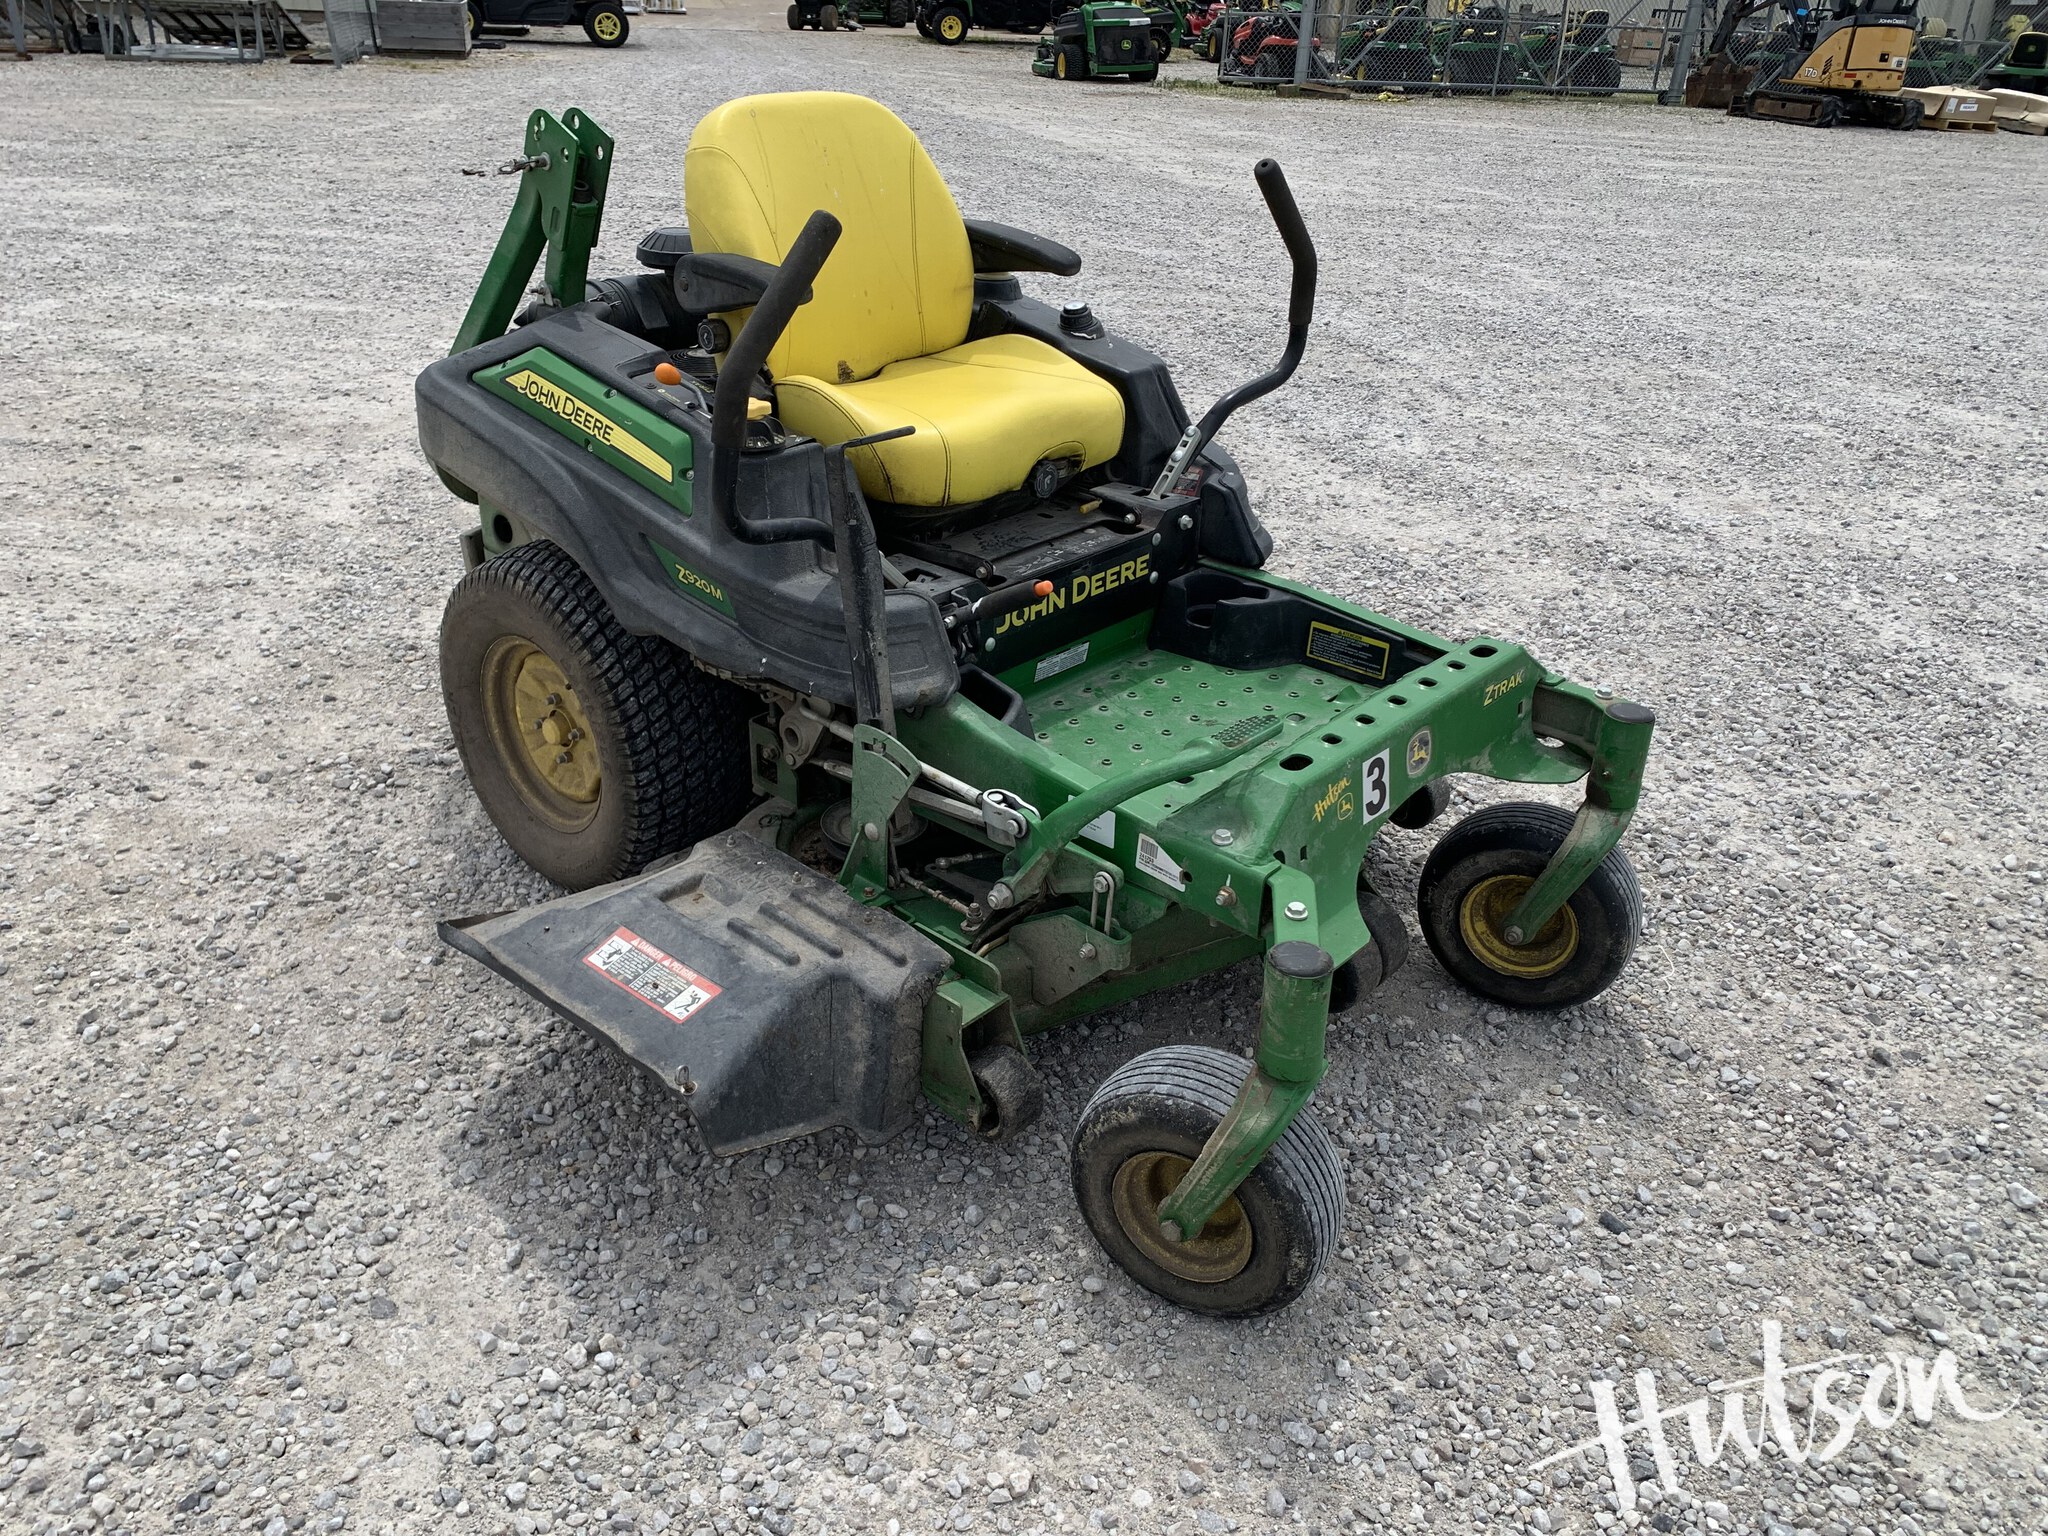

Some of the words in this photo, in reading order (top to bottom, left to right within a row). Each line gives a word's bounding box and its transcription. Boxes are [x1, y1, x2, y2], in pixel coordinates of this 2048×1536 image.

[1804, 67, 1819, 78] 17D
[519, 374, 560, 411] JOHN
[561, 396, 614, 443] DEERE
[675, 563, 723, 601] Z920M
[996, 588, 1065, 634] JOHN
[1072, 554, 1150, 603] DEERE
[1483, 671, 1523, 707] ZTRAK
[1312, 776, 1351, 822] Hutson
[1365, 757, 1387, 816] 3
[638, 941, 664, 960] DANGER
[669, 961, 698, 982] PELIGRO
